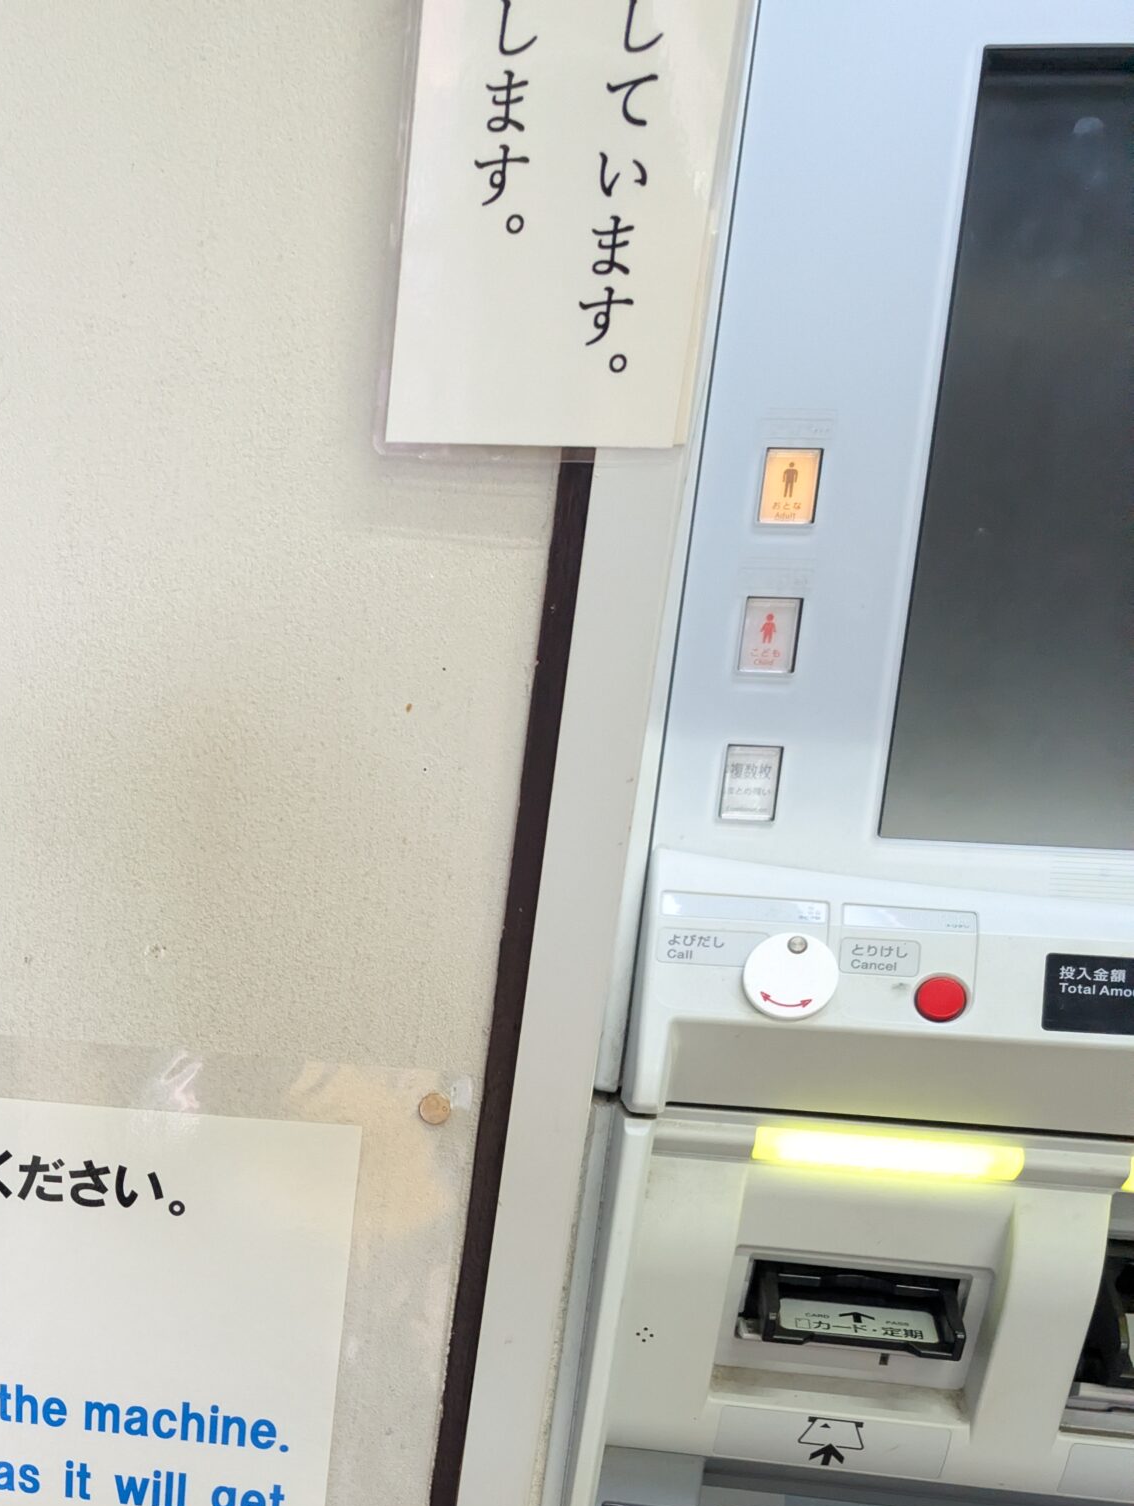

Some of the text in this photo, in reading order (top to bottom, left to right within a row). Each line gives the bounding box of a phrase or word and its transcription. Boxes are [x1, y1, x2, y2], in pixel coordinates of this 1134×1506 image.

[473, 0, 539, 235] します。
[579, 0, 664, 374] しています。
[772, 502, 802, 510] おとな
[667, 934, 725, 949] よびだし
[667, 948, 693, 960] Call
[851, 943, 908, 959] とりけし
[850, 958, 898, 972] Cancel
[1058, 965, 1127, 984] 投入金額
[1058, 982, 1134, 998] Total Amo
[83, 1400, 291, 1454] machine.
[65, 1460, 91, 1501] it
